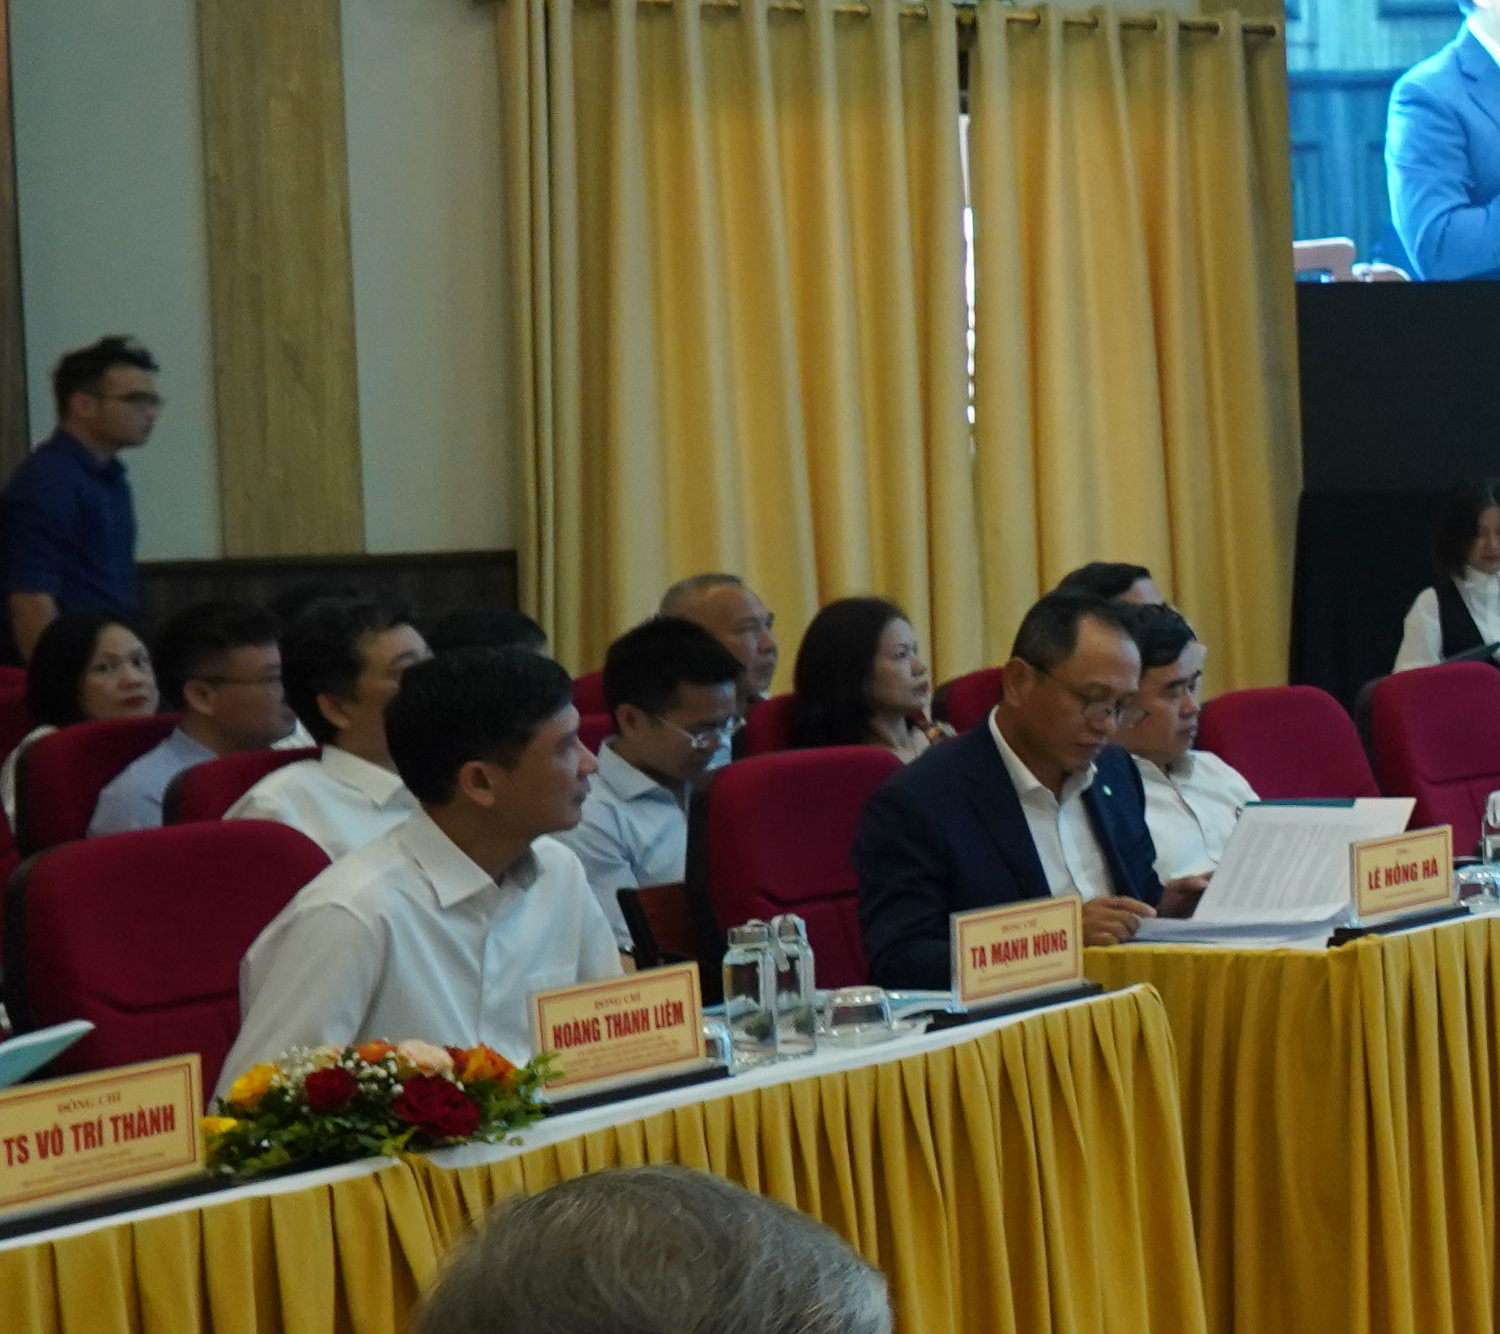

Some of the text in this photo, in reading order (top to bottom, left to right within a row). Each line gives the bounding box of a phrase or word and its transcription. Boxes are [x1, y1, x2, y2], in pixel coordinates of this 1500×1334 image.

[1385, 860, 1419, 887] HỒNG
[970, 929, 1068, 971] TẠ MẠNH HÙNG
[552, 1016, 602, 1049] HOÀNG
[604, 1007, 650, 1040] THANH
[3, 1134, 30, 1167] TS
[70, 1114, 103, 1152] TRÍ
[109, 1103, 176, 1144] THÀNH
